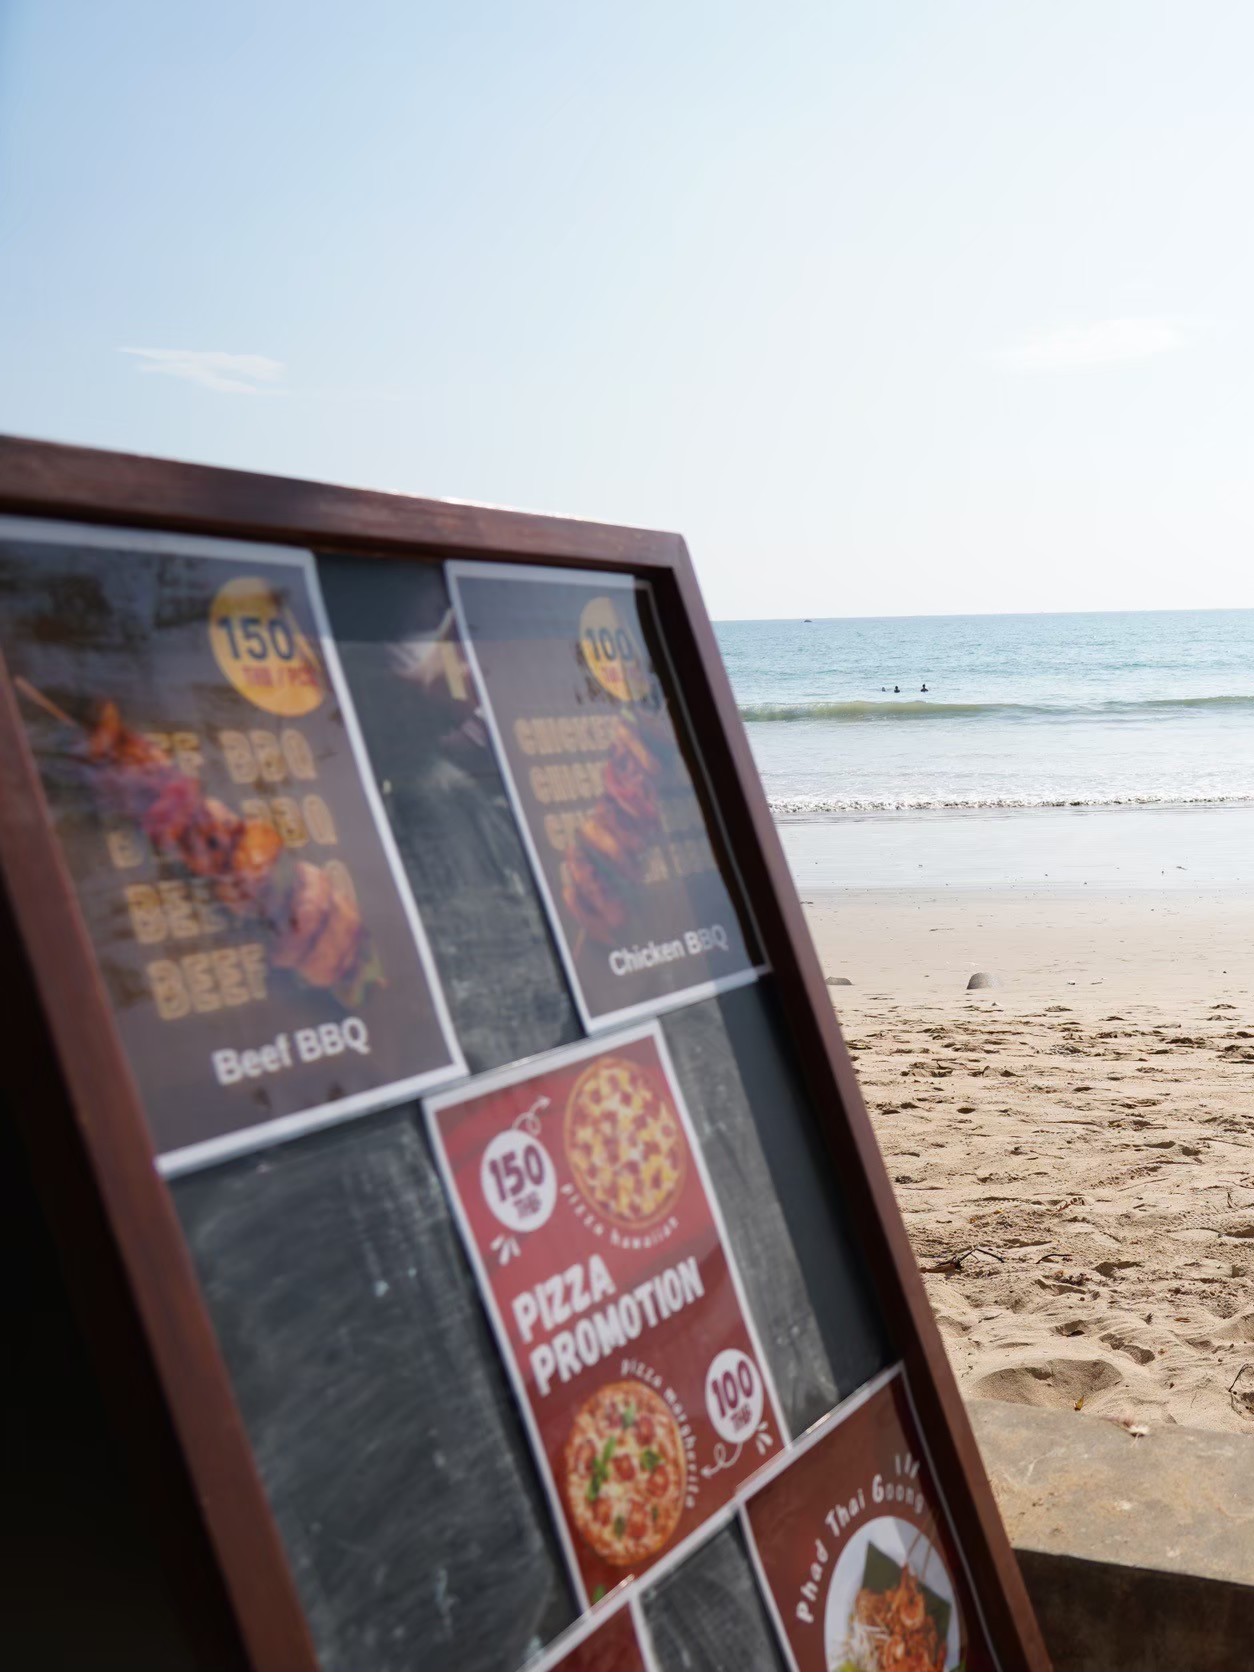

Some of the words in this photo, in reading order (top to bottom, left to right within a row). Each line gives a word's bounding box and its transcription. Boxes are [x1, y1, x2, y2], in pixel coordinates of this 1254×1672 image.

[217, 616, 294, 661] 150
[584, 626, 634, 661] 100
[146, 942, 267, 1020] BEEF
[608, 940, 686, 977] Chicken
[683, 923, 730, 956] BBQ
[211, 1032, 293, 1086] Beef
[294, 1015, 372, 1063] BBQ
[488, 1143, 546, 1203] 150
[511, 1253, 618, 1344] PIZZA
[529, 1255, 706, 1398] PROMOTION
[711, 1359, 754, 1419] 100
[795, 1538, 830, 1625] Phad
[824, 1487, 867, 1538] Thai
[871, 1473, 926, 1516] Goong
